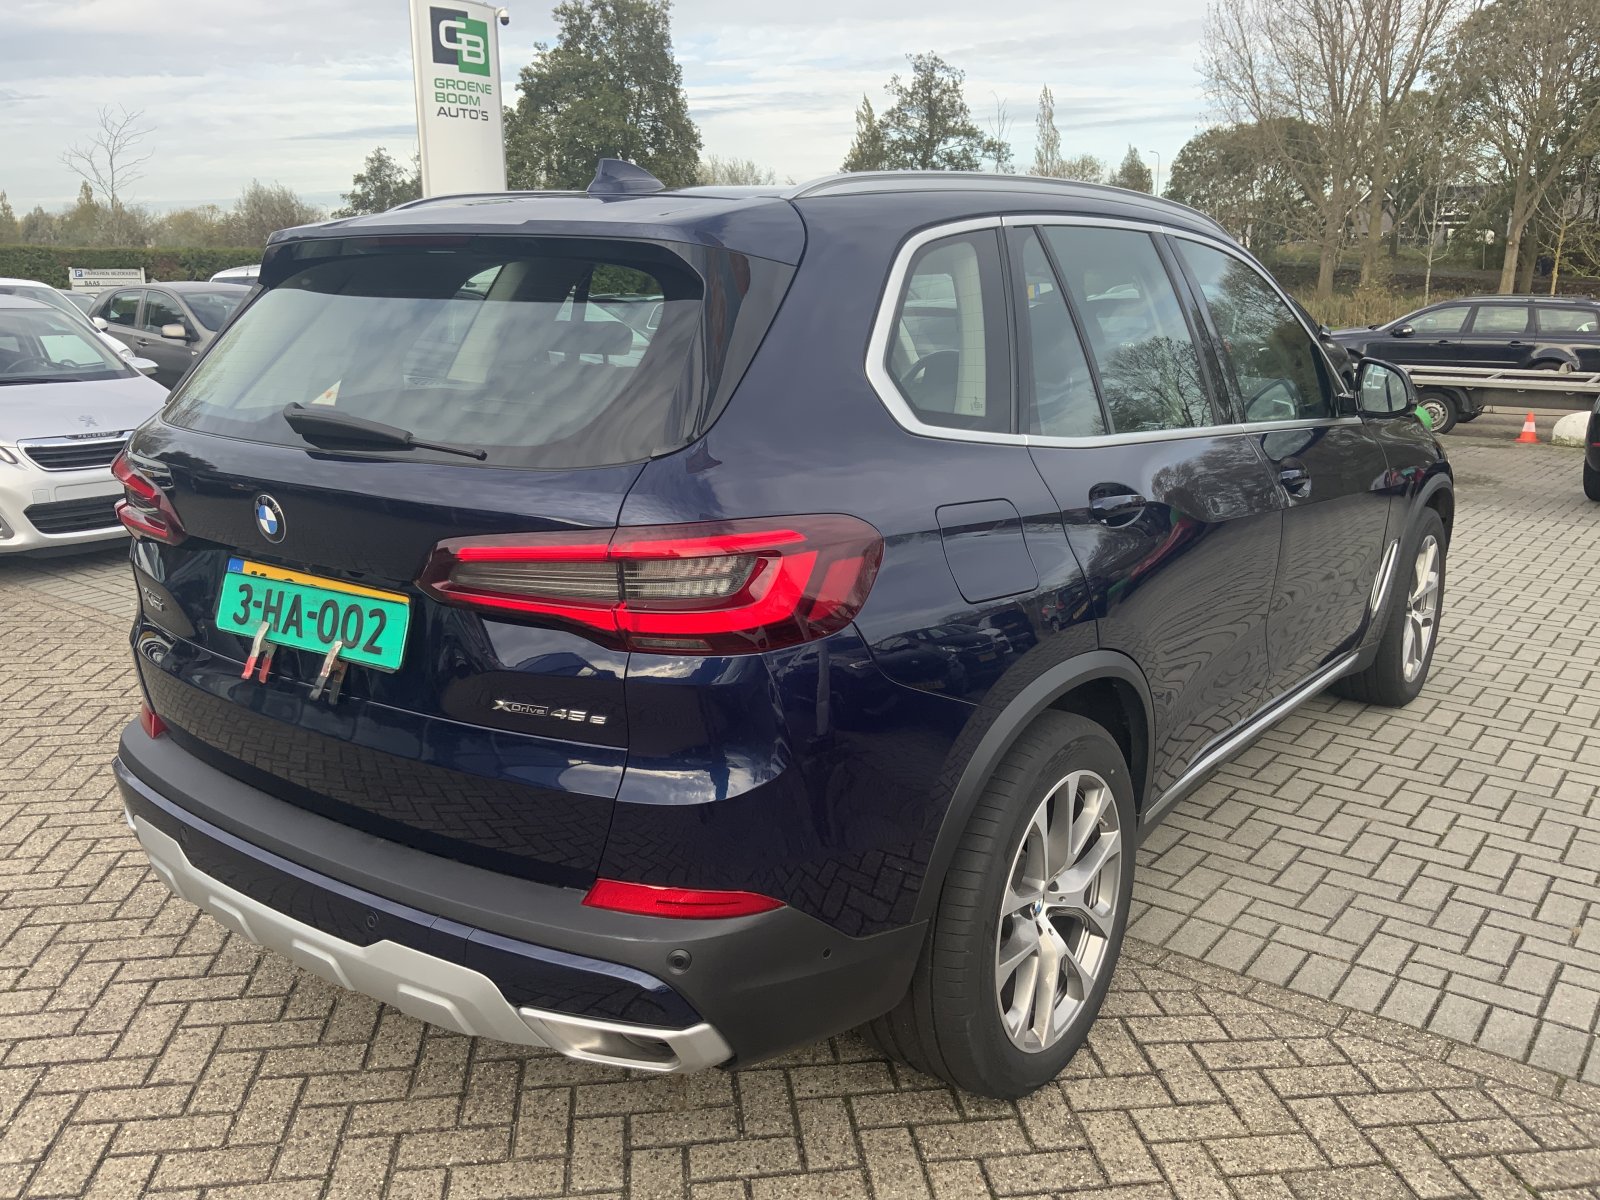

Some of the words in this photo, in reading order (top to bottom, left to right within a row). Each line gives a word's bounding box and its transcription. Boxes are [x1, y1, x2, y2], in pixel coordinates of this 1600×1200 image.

[434, 77, 492, 95] GROENE
[435, 91, 481, 107] BOOM
[436, 106, 489, 121] AUTO'S
[232, 583, 387, 655] 3-HA-002
